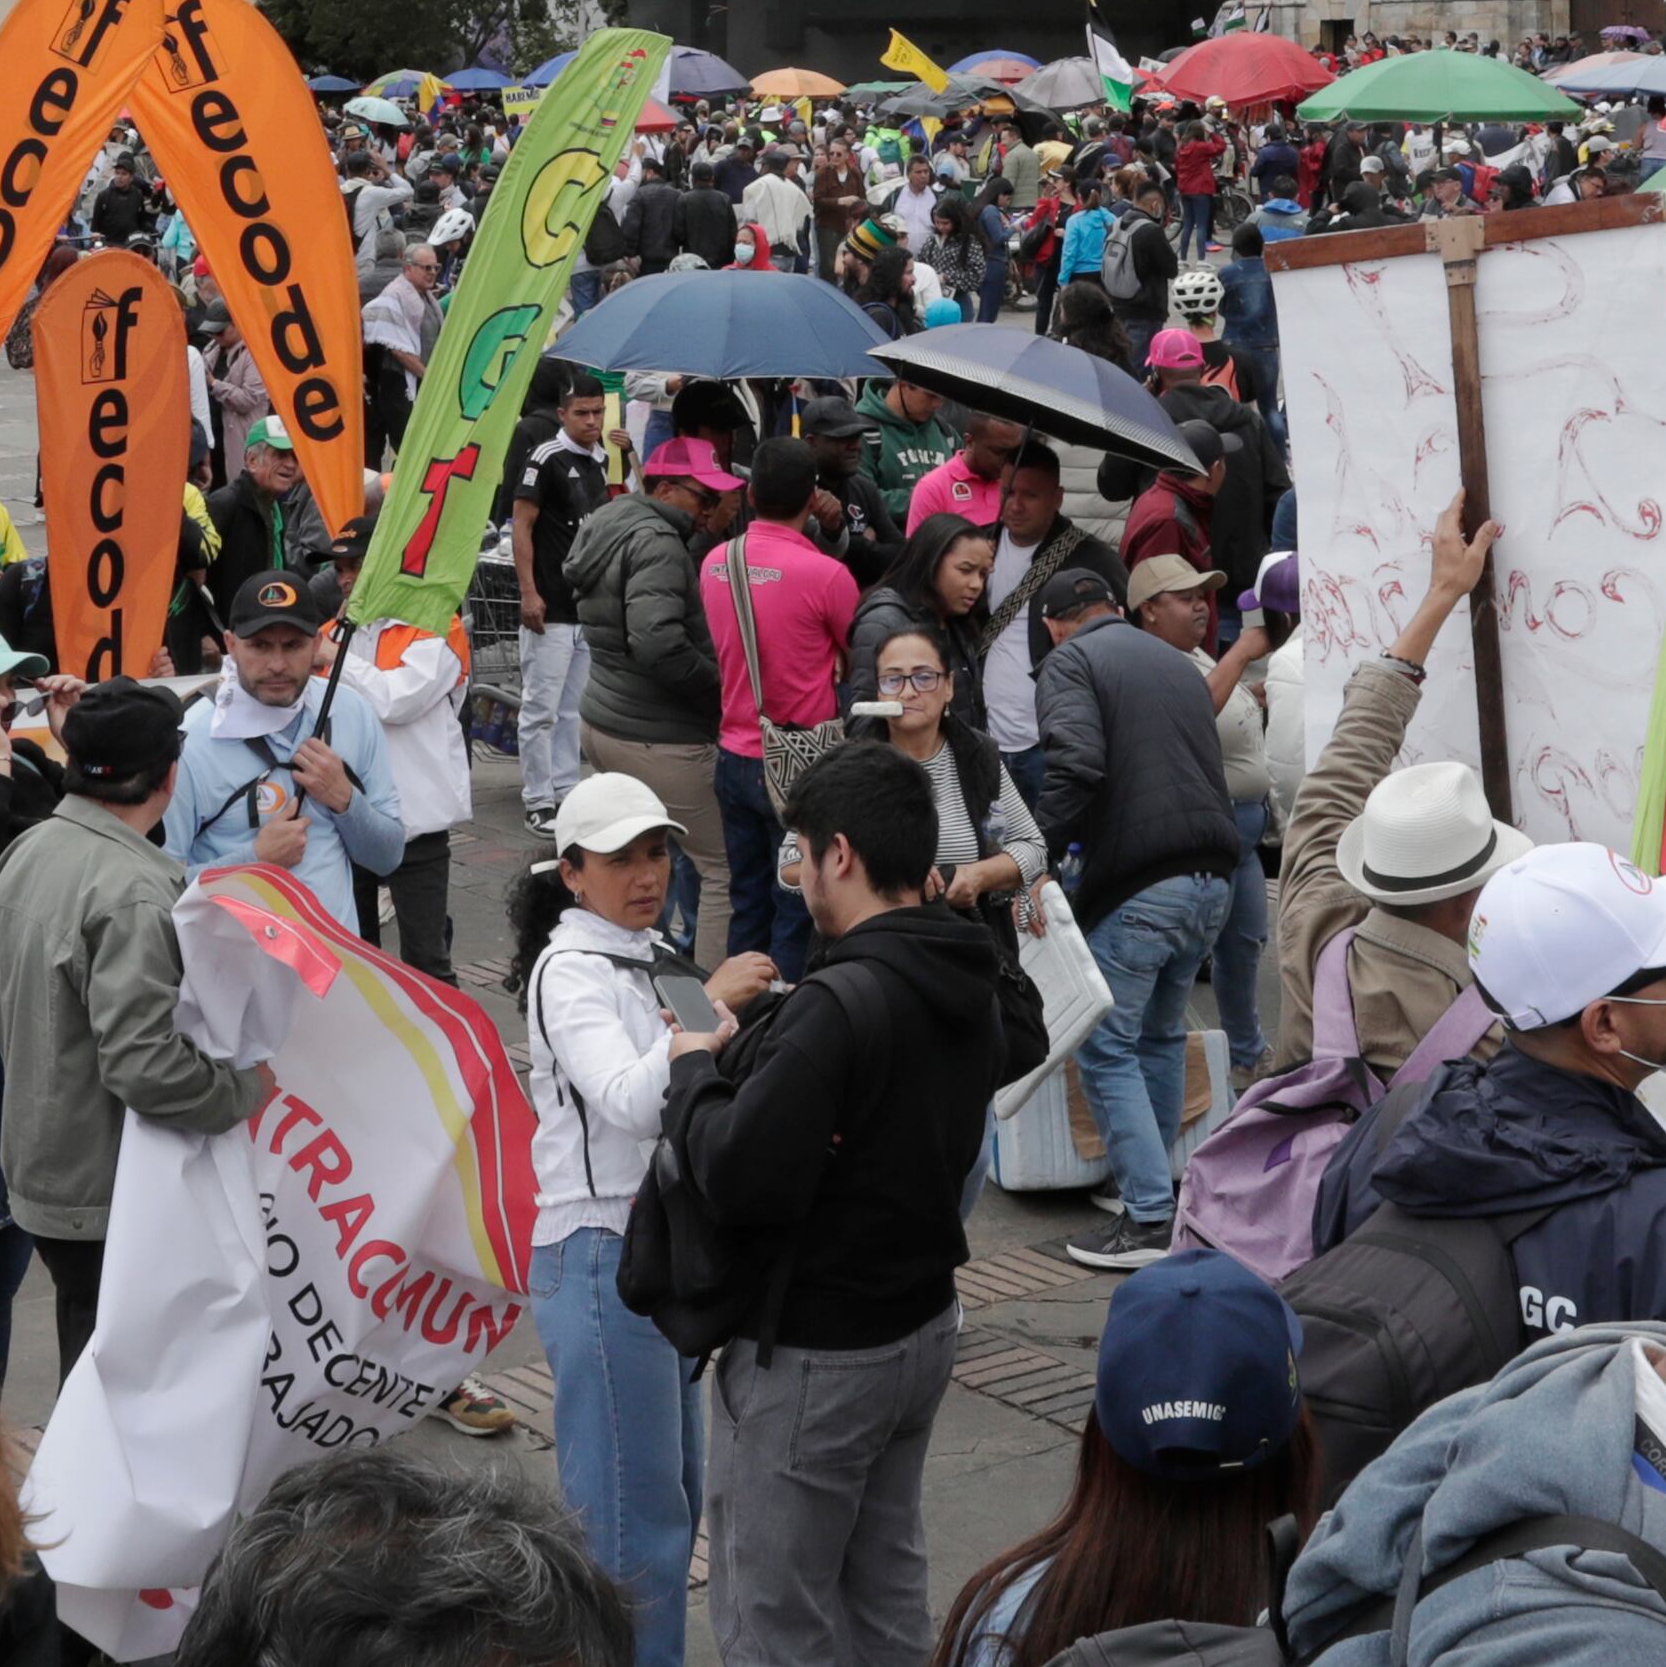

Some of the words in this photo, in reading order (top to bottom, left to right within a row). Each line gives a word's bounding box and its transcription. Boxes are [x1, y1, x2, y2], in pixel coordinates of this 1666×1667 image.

[86, 287, 142, 681] fecod
[288, 1282, 435, 1418] DECENTE
[1142, 1401, 1226, 1425] UNASEMIG
